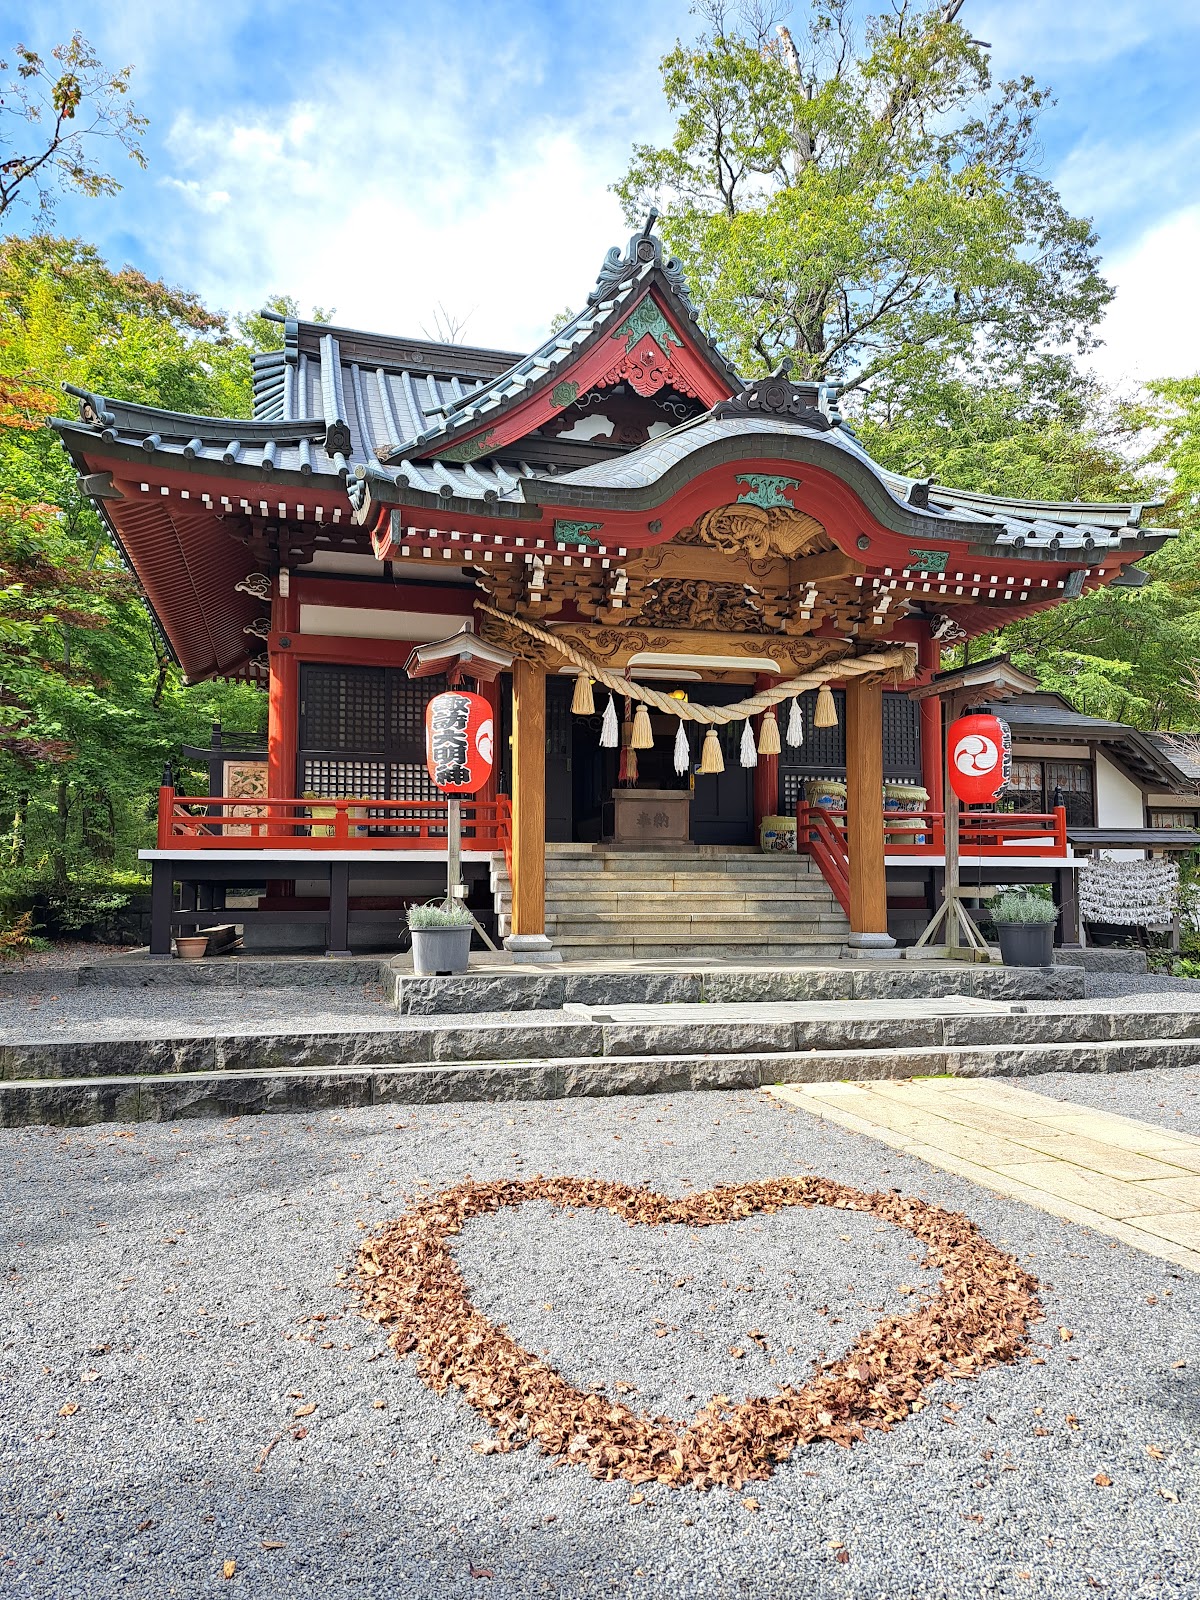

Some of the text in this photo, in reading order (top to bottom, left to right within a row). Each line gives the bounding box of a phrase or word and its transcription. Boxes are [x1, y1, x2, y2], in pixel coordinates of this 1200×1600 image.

[432, 694, 471, 785] 諏訪大明神
[636, 811, 670, 829] 奉納
